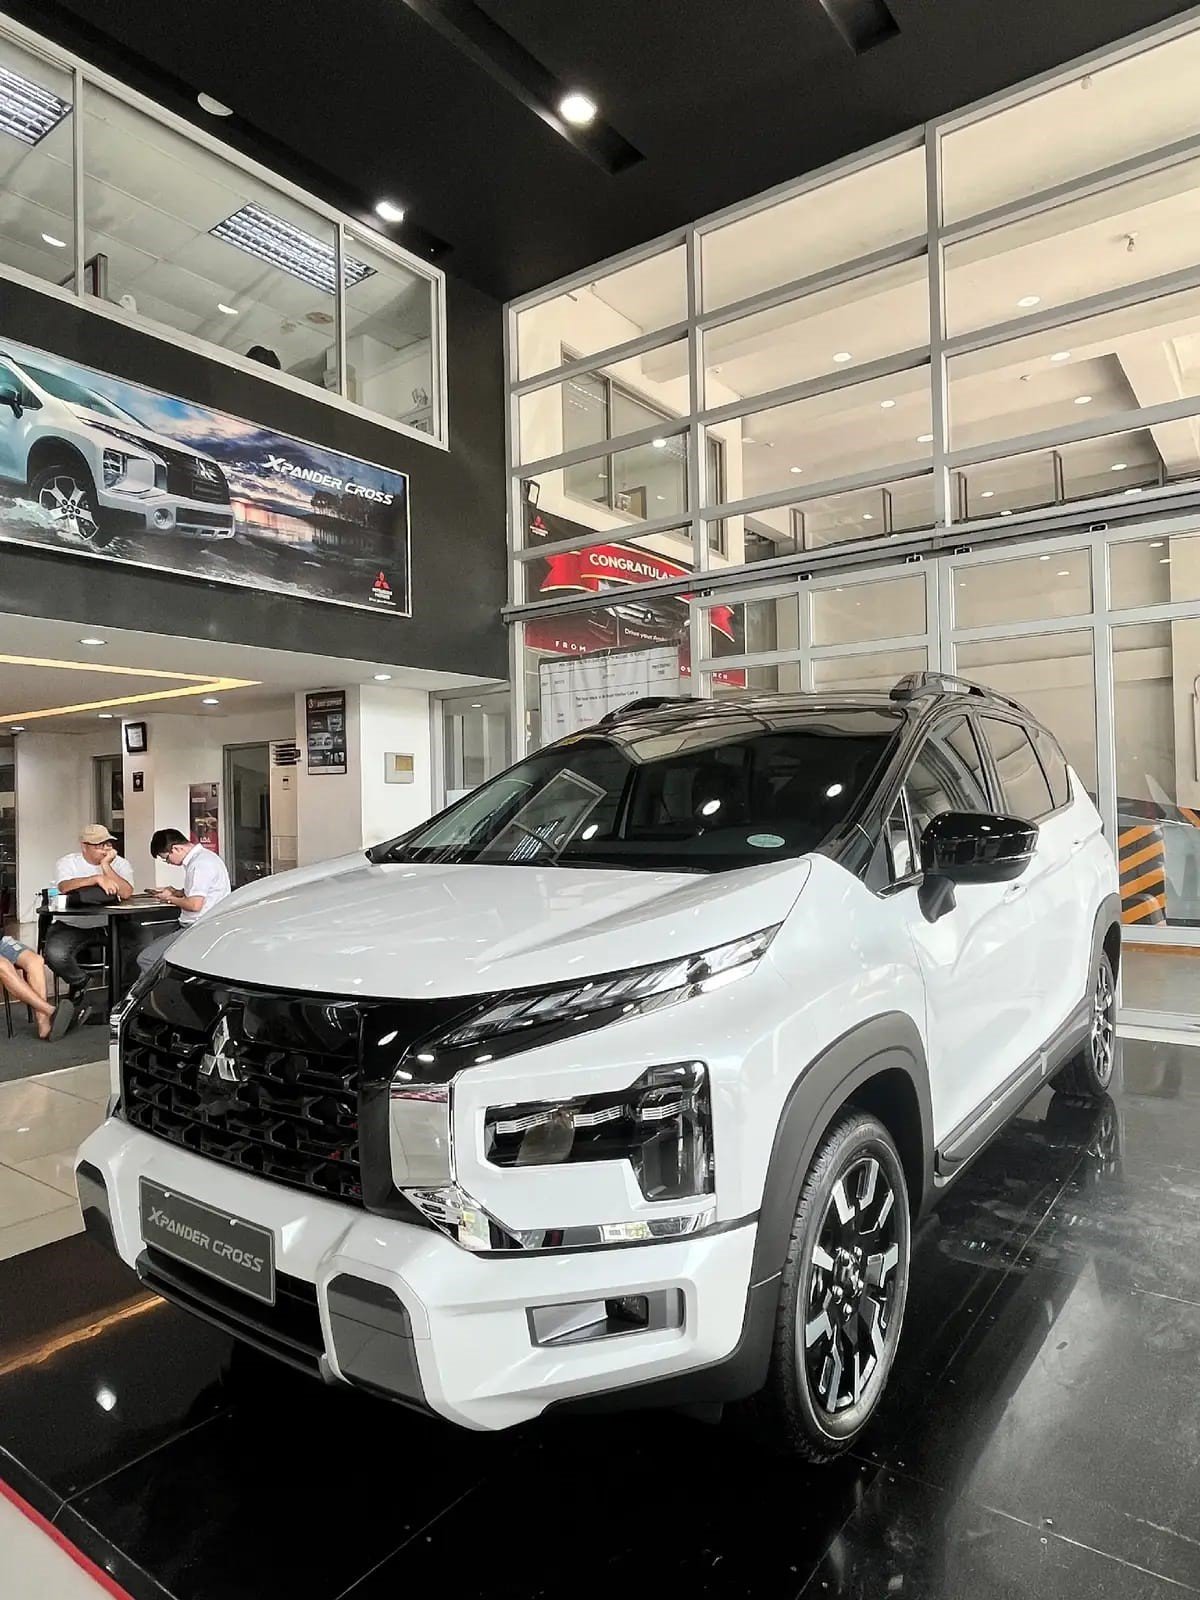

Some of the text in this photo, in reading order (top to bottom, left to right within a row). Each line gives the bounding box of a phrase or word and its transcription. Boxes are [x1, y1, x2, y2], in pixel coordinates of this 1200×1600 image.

[262, 454, 394, 506] XPANDER CROSS
[555, 640, 587, 652] FROM
[147, 1206, 264, 1273] XPANDER CROSS
